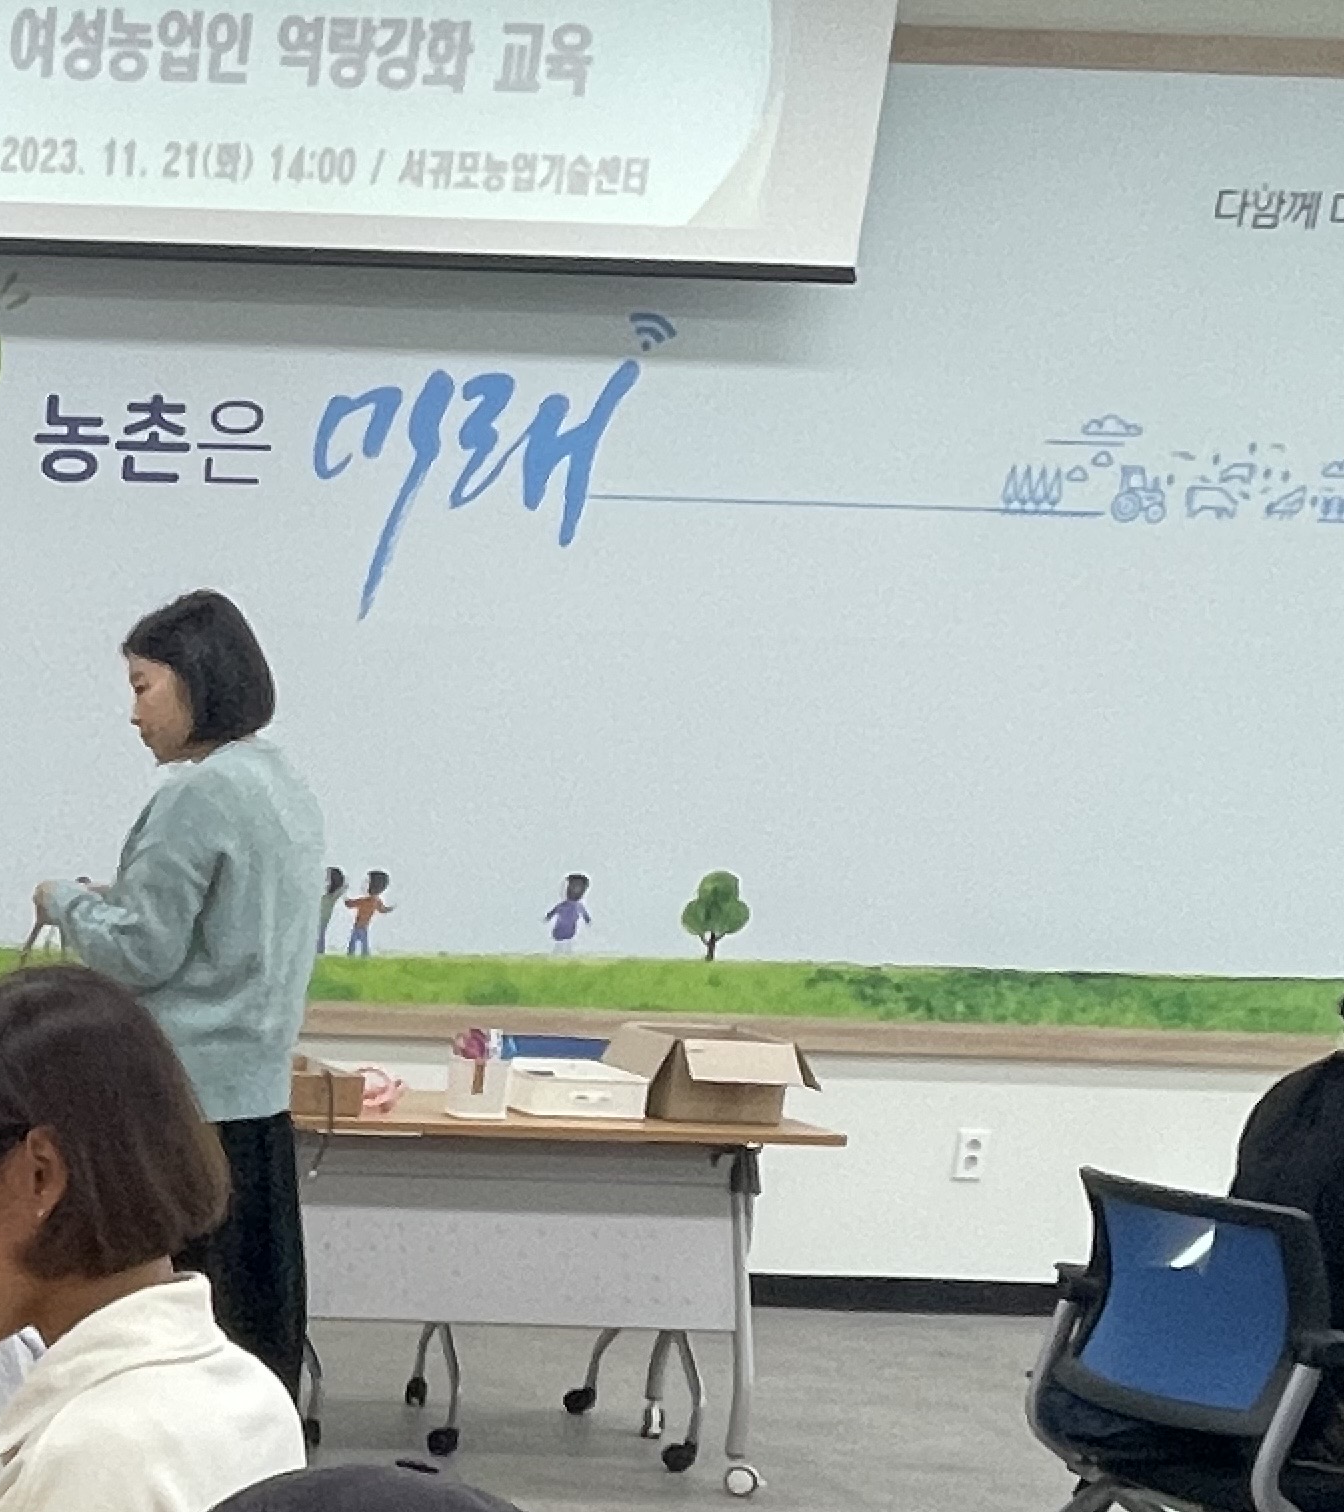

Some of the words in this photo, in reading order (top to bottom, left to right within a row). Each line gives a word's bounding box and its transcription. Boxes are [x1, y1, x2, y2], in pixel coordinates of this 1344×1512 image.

[10, 6, 254, 85] 여성농업인
[277, 14, 475, 95] 역량강화
[492, 21, 595, 98] 교육
[0, 135, 86, 176] 2023.
[162, 140, 255, 184] 21(화)
[269, 144, 357, 186] 14:00
[1214, 182, 1324, 230] 다함께
[33, 393, 273, 486] 농촌은
[313, 358, 640, 622] 미래
